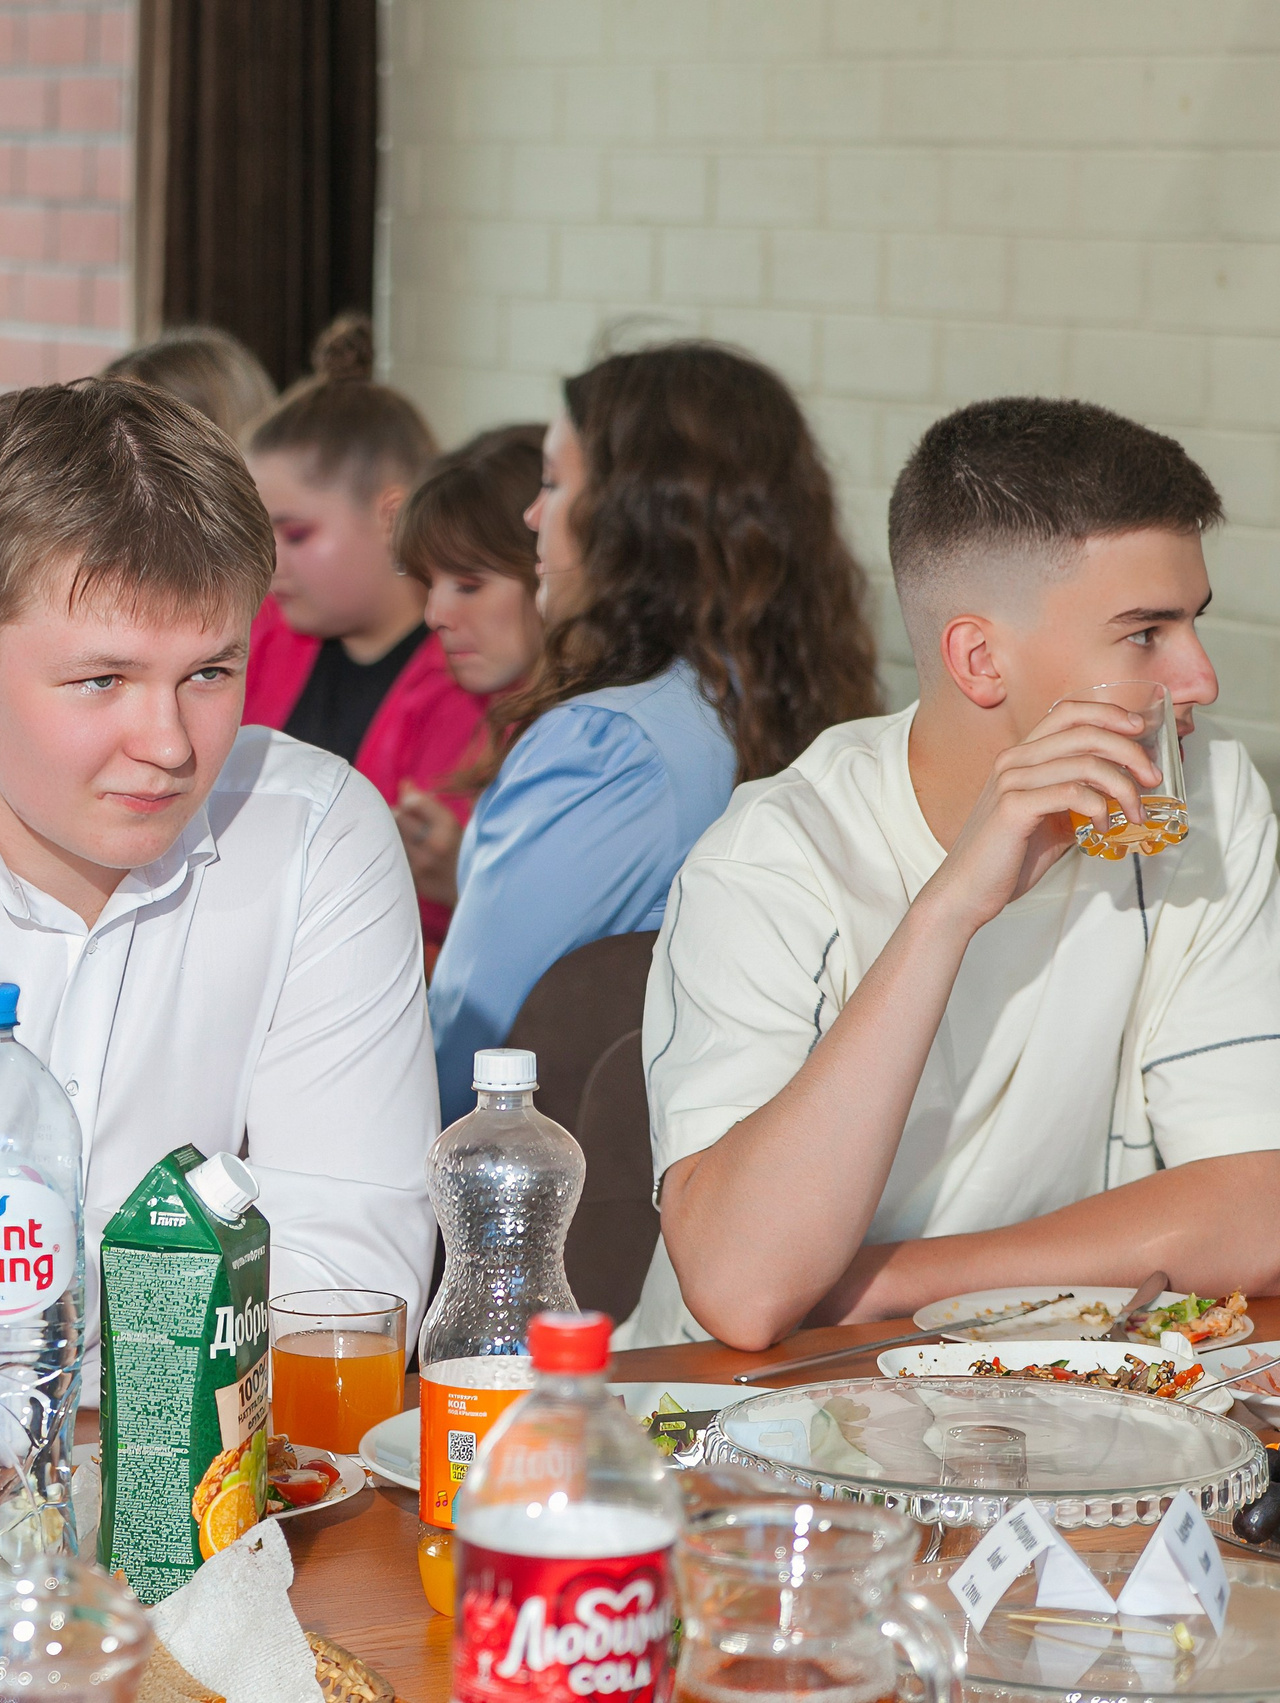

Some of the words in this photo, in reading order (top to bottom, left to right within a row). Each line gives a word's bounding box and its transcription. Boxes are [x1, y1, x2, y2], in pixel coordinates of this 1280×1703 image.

[210, 1296, 270, 1360] Добры
[448, 1400, 466, 1410] КОД
[568, 1656, 652, 1697] COLA
